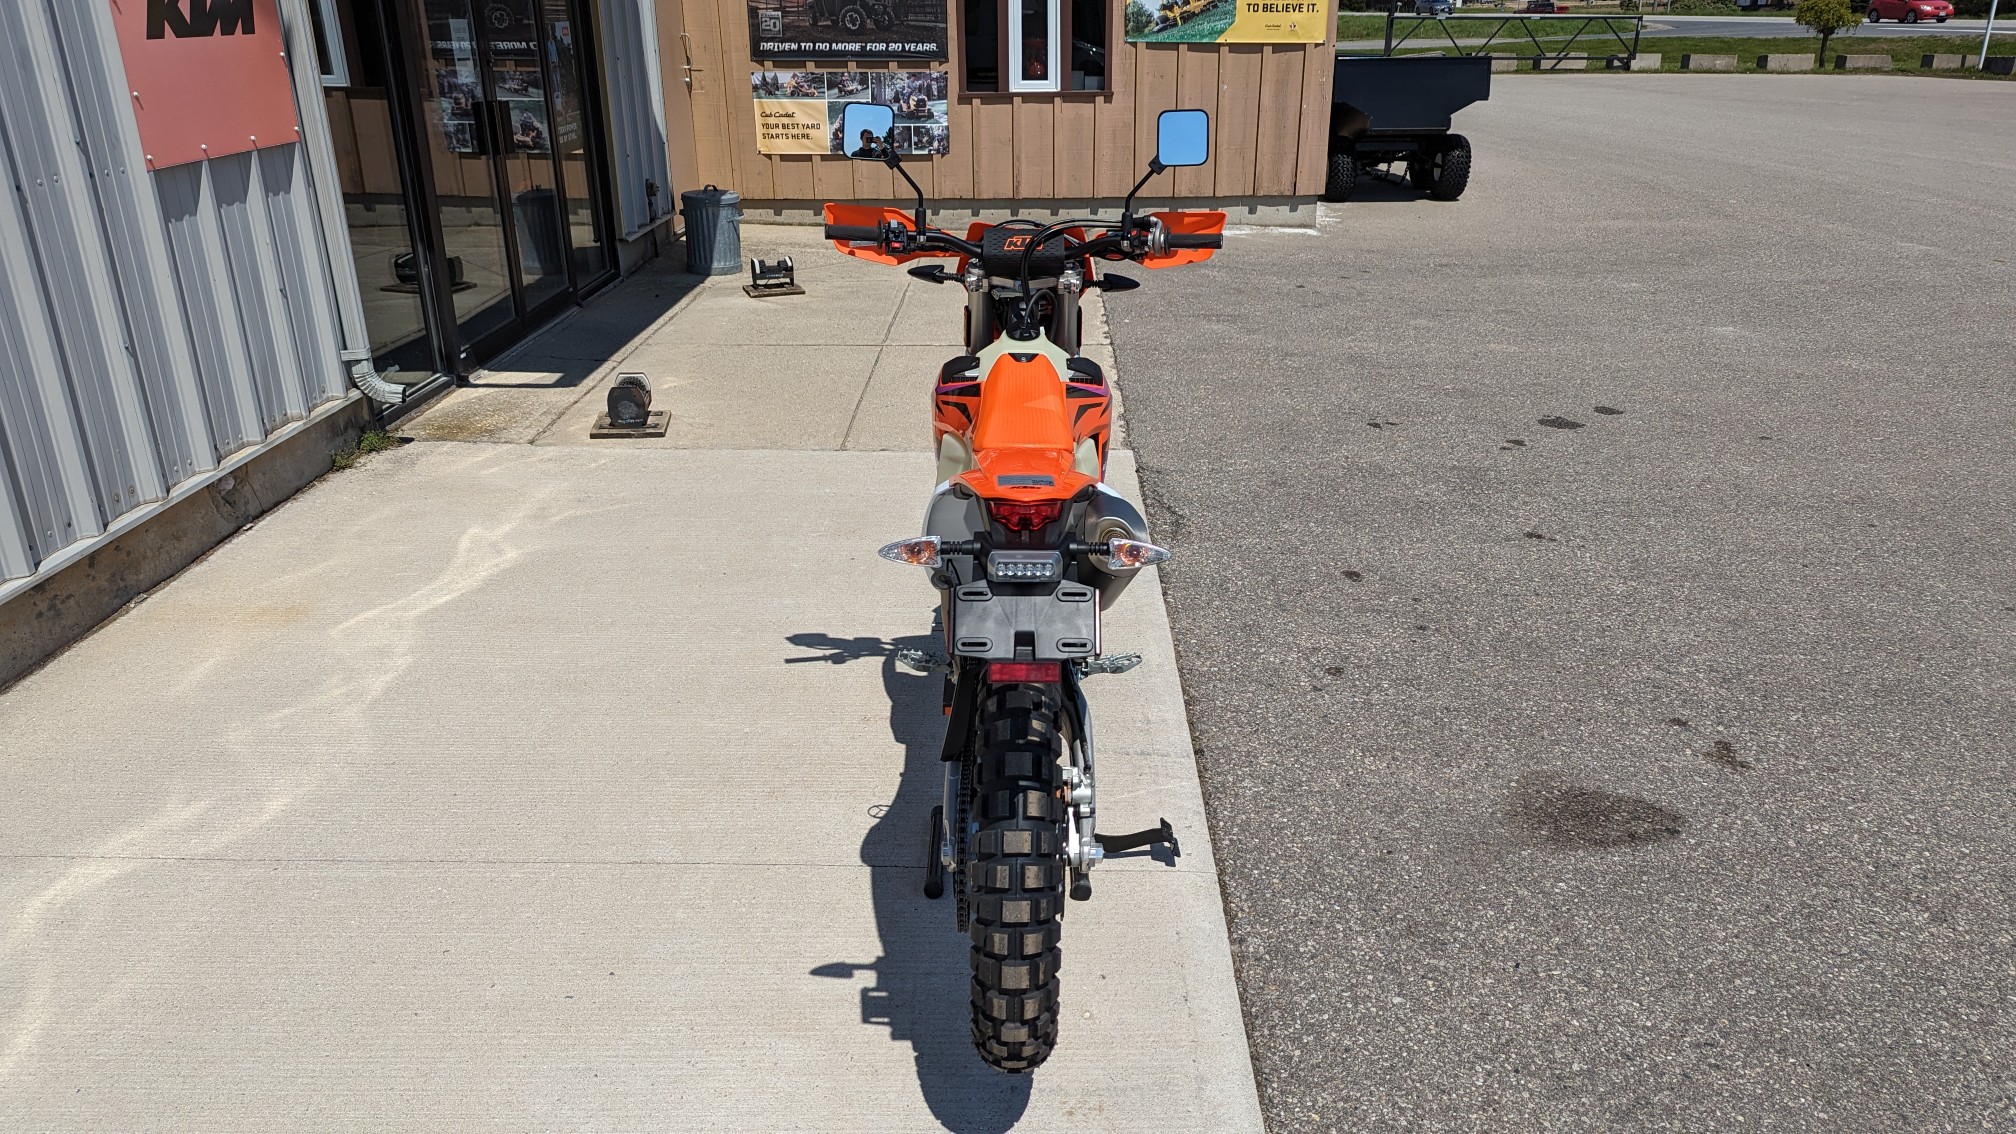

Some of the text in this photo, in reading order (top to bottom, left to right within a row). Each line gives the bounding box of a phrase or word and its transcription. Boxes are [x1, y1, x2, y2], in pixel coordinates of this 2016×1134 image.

[1246, 3, 1319, 13] TO BELIEVE IT.
[762, 17, 780, 31] 20
[760, 42, 799, 51] DRIVEN
[800, 42, 813, 51] TO
[817, 42, 830, 51] DO
[866, 42, 887, 51] FOR
[888, 42, 901, 51] 20
[904, 42, 939, 51] YEARS.
[762, 132, 813, 140] STARTS HERE.
[1004, 236, 1044, 250] KT
